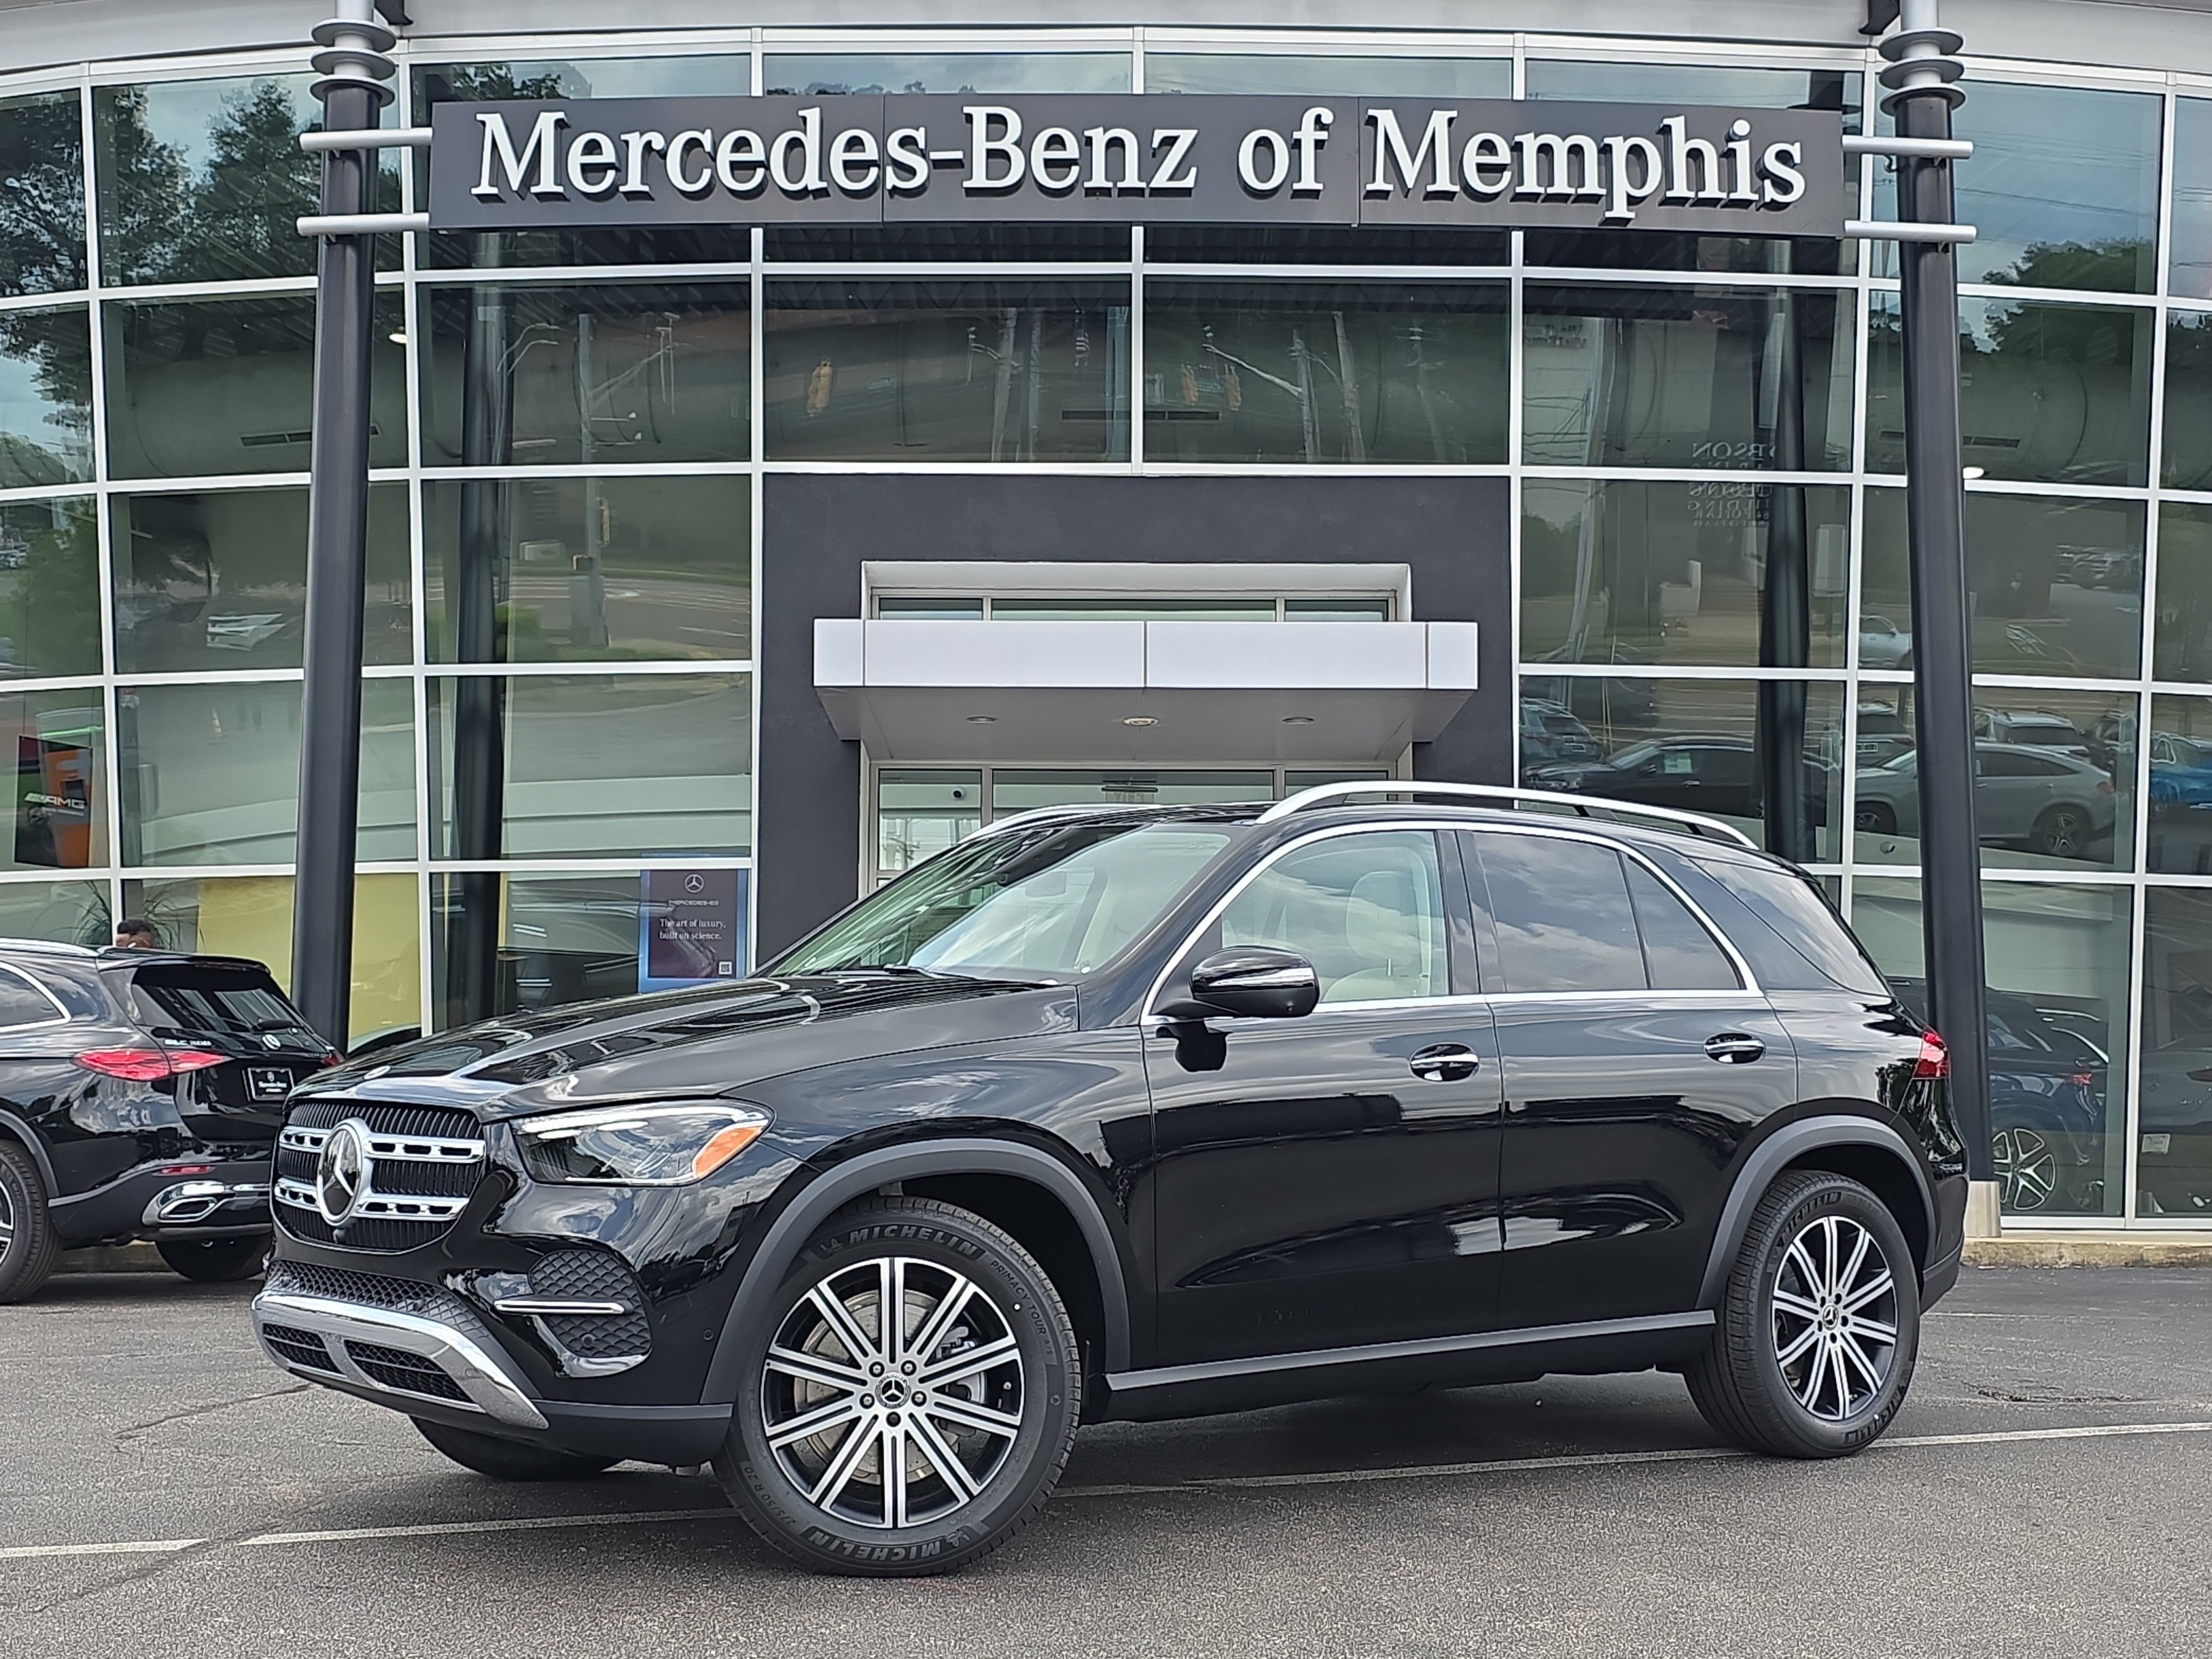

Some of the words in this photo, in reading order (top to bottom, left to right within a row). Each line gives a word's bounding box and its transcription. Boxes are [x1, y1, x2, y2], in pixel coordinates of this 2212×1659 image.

[470, 106, 1199, 196] Mercedes-Benz
[1238, 107, 1334, 191] of
[1365, 108, 1806, 218] Memphis
[44, 795, 86, 809] AMG
[660, 918, 674, 928] The
[676, 919, 687, 928] art
[689, 918, 697, 928] of
[698, 918, 726, 929] luxury,
[660, 931, 678, 940] built
[690, 931, 722, 940] science.
[849, 1224, 978, 1257] MICHELIN
[989, 1260, 1030, 1300] PRIMACY
[1027, 1304, 1046, 1335] TOUR
[808, 1530, 942, 1562] MICHELIN
